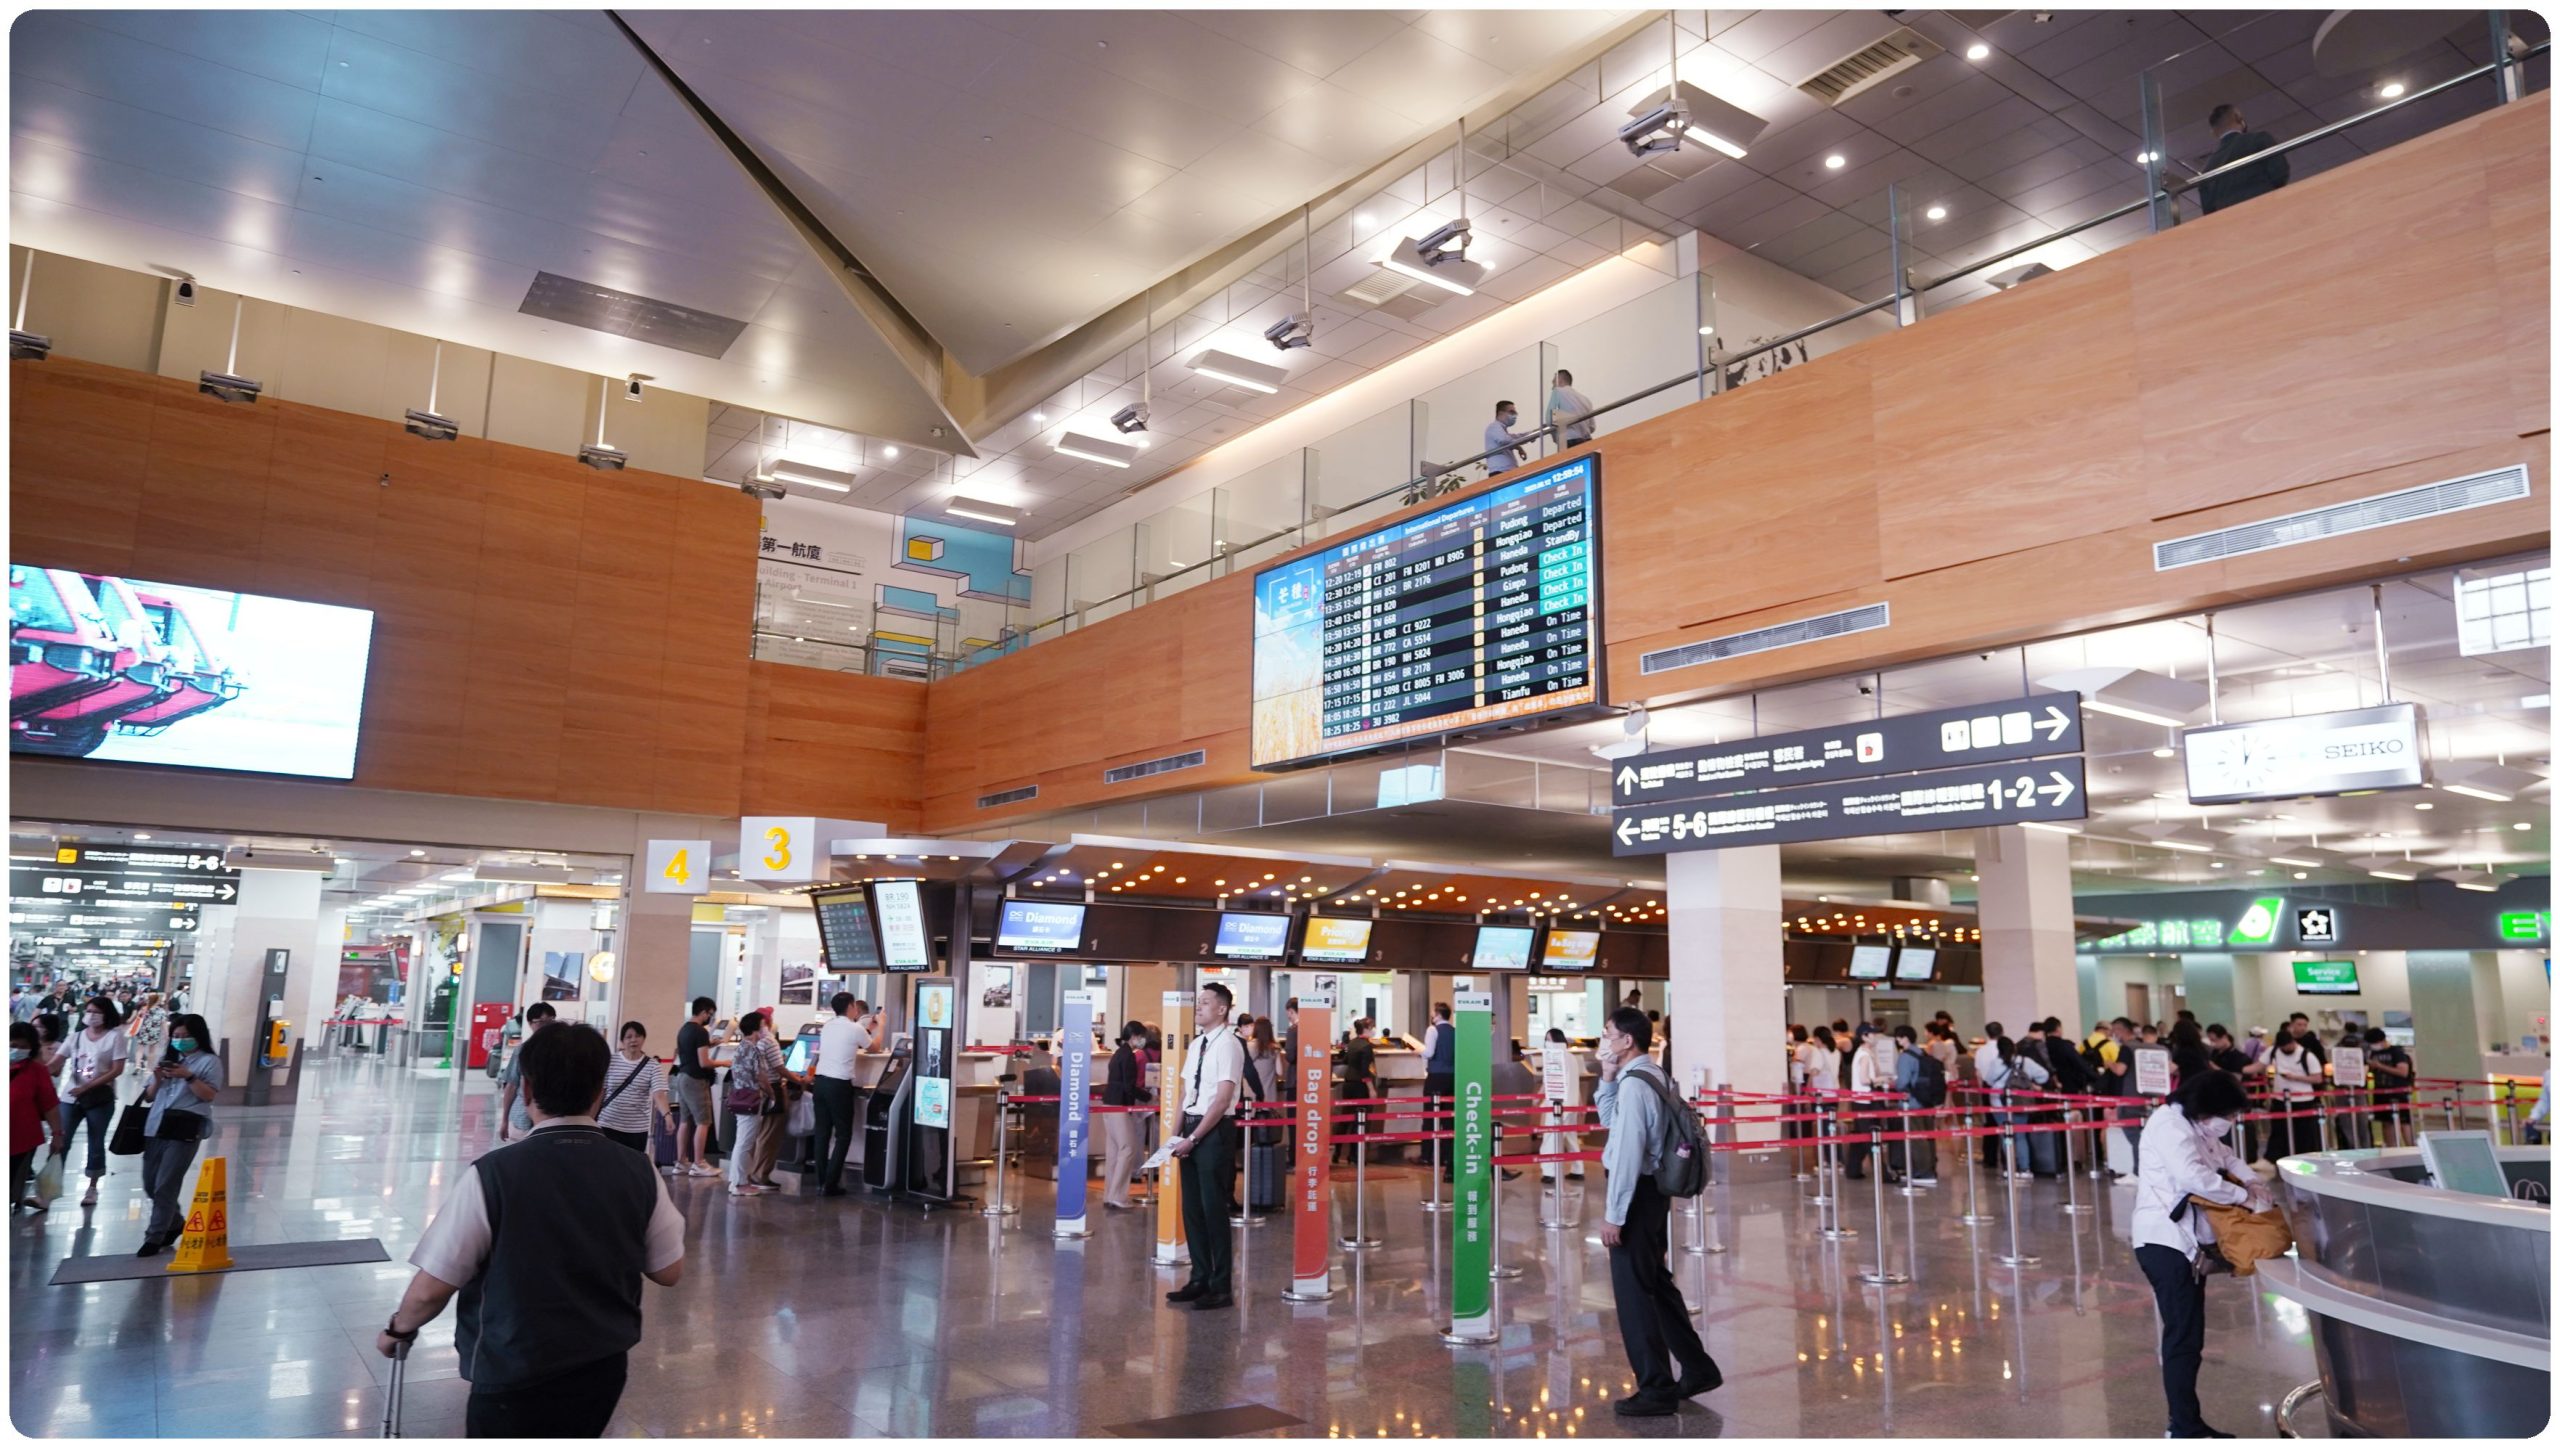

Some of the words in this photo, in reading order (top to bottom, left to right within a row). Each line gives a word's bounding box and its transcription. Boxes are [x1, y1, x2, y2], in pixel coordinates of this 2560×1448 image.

[1405, 516, 1441, 534] International
[1442, 506, 1475, 522] Departures
[760, 536, 822, 560] 第一航廈
[1326, 576, 1342, 588] 12:20
[1344, 569, 1361, 581] 12:19
[1501, 516, 1528, 531] Pudong
[1543, 496, 1581, 517] Departed
[1326, 589, 1342, 602] 12:30
[1344, 583, 1361, 595] 12:09
[1415, 561, 1430, 573] 8201
[1447, 550, 1464, 562] 8905
[1496, 530, 1533, 547] Hongqiao
[1543, 513, 1582, 532] Departed
[760, 566, 796, 582] uilding
[804, 574, 849, 589] Terminal
[764, 578, 802, 591] Airport
[1325, 603, 1342, 615] 13:35
[1344, 597, 1361, 609] 13:40
[1415, 576, 1430, 588] 2176
[1501, 546, 1528, 561] Haneda
[1546, 530, 1579, 547] StandBy
[1325, 616, 1342, 629] 13:40
[1344, 610, 1361, 622] 13:40
[1501, 562, 1528, 576] Pudong
[1543, 550, 1568, 564] Check
[1573, 546, 1582, 555] In
[1325, 630, 1342, 642] 13:50
[1344, 624, 1361, 636] 13:55
[1503, 578, 1526, 591] Gimpo
[1544, 566, 1568, 579] Check
[1573, 562, 1582, 571] In
[1325, 644, 1342, 656] 14:20
[1344, 638, 1361, 650] 14:20
[1415, 619, 1430, 631] 9222
[1501, 593, 1529, 607] Haneda
[1544, 582, 1568, 595] Check
[1574, 578, 1582, 587] In
[1325, 657, 1342, 669] 14:30
[1344, 652, 1360, 664] 14:30
[1415, 634, 1431, 646] 5514
[1497, 607, 1533, 623] Hongqiao
[1544, 598, 1568, 611] Check
[1574, 594, 1583, 604] In
[1325, 671, 1342, 683] 16:00
[1343, 666, 1360, 678] 16:00
[1415, 648, 1431, 660] 5824
[1501, 624, 1529, 638] Haneda
[1547, 616, 1557, 626] On
[1561, 611, 1581, 622] Time
[1324, 685, 1341, 696] 16:50
[1343, 680, 1360, 692] 16:50
[1415, 663, 1431, 675] 2178
[1501, 640, 1529, 654] Haneda
[1547, 633, 1557, 642] On
[1561, 627, 1581, 638] Time
[1324, 698, 1341, 710] 17:15
[1343, 694, 1360, 706] 17:15
[1415, 677, 1431, 689] 8005
[1448, 669, 1465, 682] 3006
[1497, 655, 1534, 671] Hongqiao
[1547, 649, 1558, 658] On
[1561, 643, 1582, 655] Time
[1324, 712, 1341, 724] 18:05
[1343, 708, 1360, 720] 18:05
[1415, 692, 1431, 704] 5044
[1502, 671, 1529, 685] Haneda
[1548, 665, 1558, 675] On
[1561, 660, 1582, 671] Time
[1324, 726, 1341, 737] 18:25
[1343, 721, 1360, 733] 18:25
[1502, 686, 1530, 700] Tianfu
[1548, 681, 1558, 691] On
[1561, 676, 1582, 688] Time
[2325, 738, 2404, 760] SEIKO
[1987, 776, 2036, 810] 1-2
[1672, 811, 1707, 839] 5-6
[187, 854, 221, 871] 5-6
[664, 848, 690, 886] 4
[763, 827, 792, 872] 3
[1025, 912, 1078, 925] Diamond
[1239, 923, 1282, 935] Diamond
[1090, 939, 1097, 951] 1
[1200, 944, 1208, 955] 2
[1375, 950, 1383, 961] 3
[1460, 953, 1468, 964] 4
[1602, 958, 1608, 969] 5
[1068, 1052, 1083, 1121] Diamond
[1163, 1065, 1175, 1130] Priority
[1303, 1069, 1322, 1104] Bag
[1303, 1109, 1322, 1155] drop
[1466, 1082, 1482, 1174] Check-in
